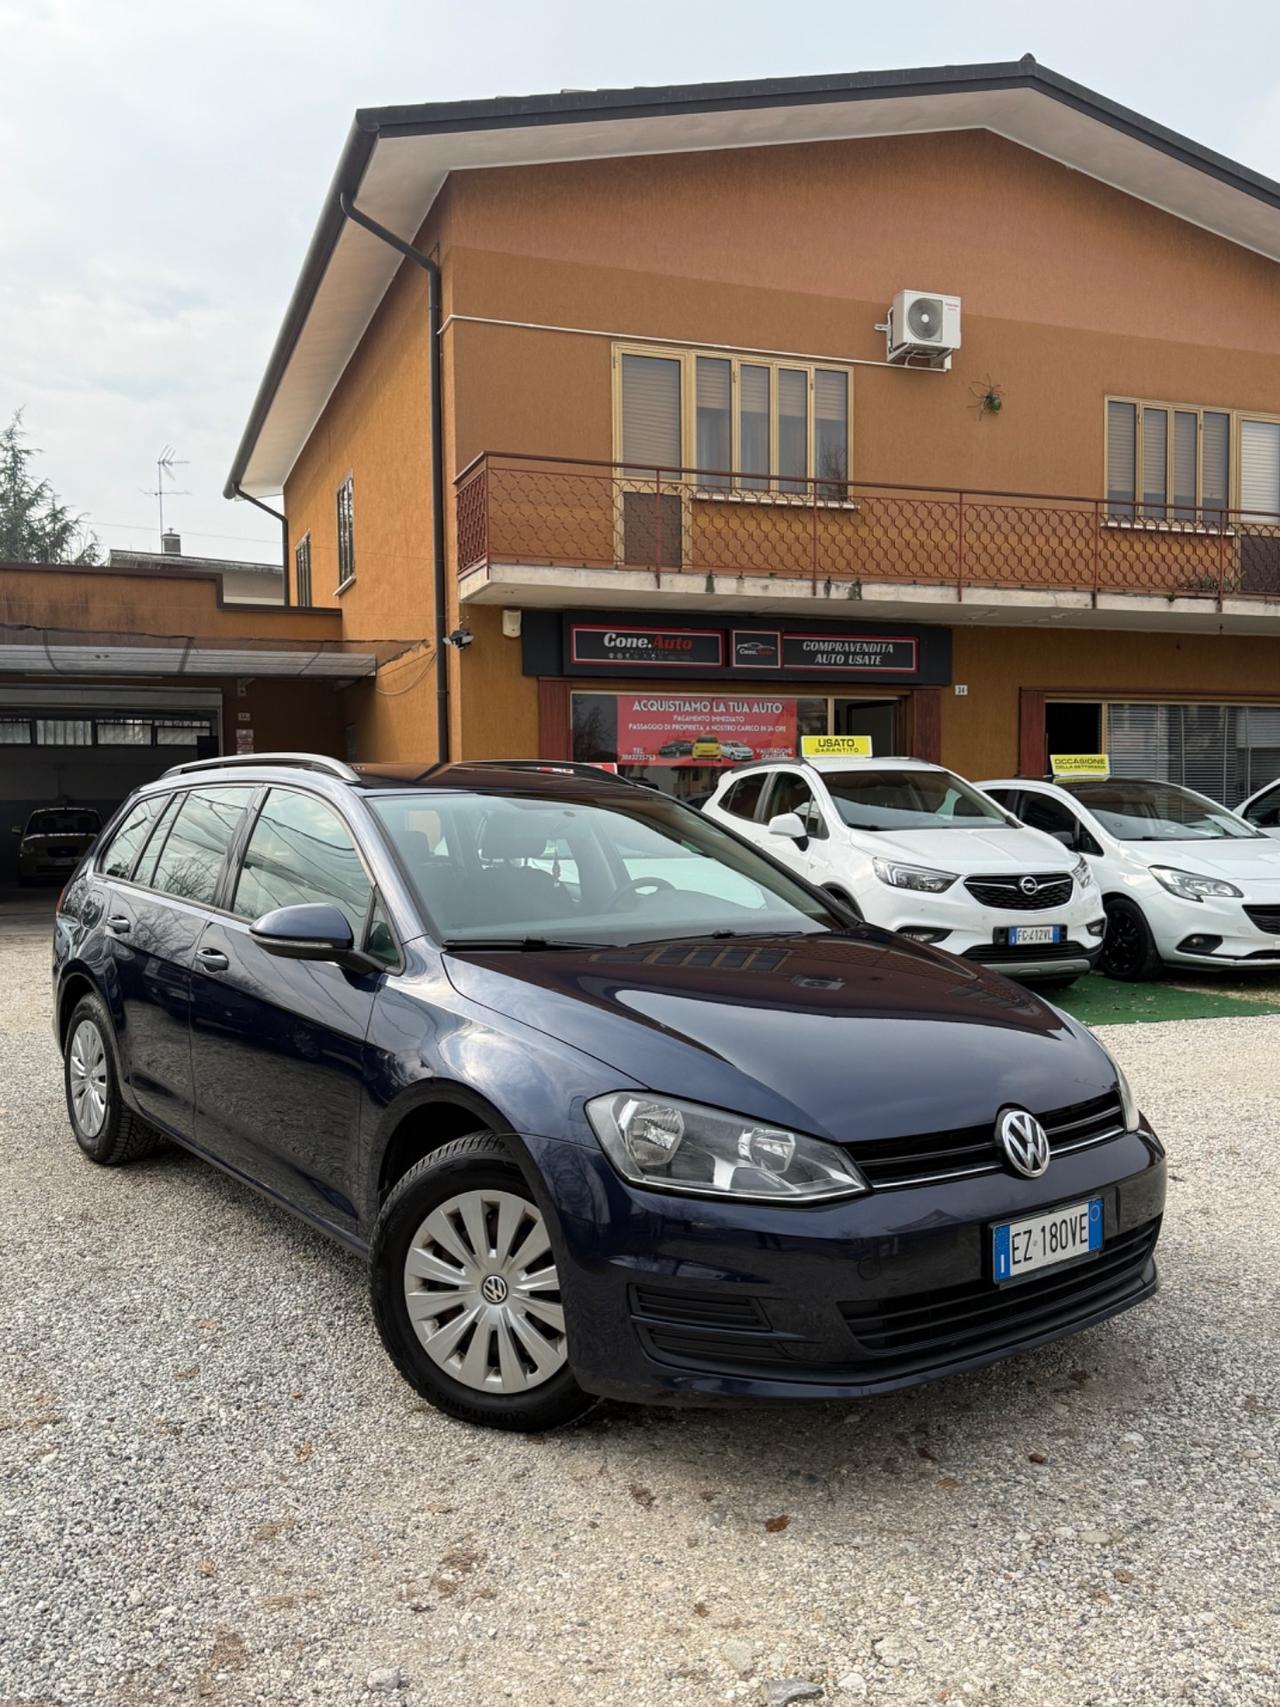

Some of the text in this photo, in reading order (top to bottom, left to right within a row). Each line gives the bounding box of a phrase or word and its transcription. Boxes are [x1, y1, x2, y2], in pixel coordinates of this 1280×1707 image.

[802, 640, 894, 653] COMPRAVENDITA
[814, 653, 883, 665] AUTO USATE
[633, 700, 783, 714] ACQUISTIAMO LA TUA AUTO
[628, 723, 664, 731] PASSAGGIO
[818, 739, 855, 748] USATO
[1011, 1229, 1033, 1266] EZ
[1041, 1212, 1089, 1257] 180VE
